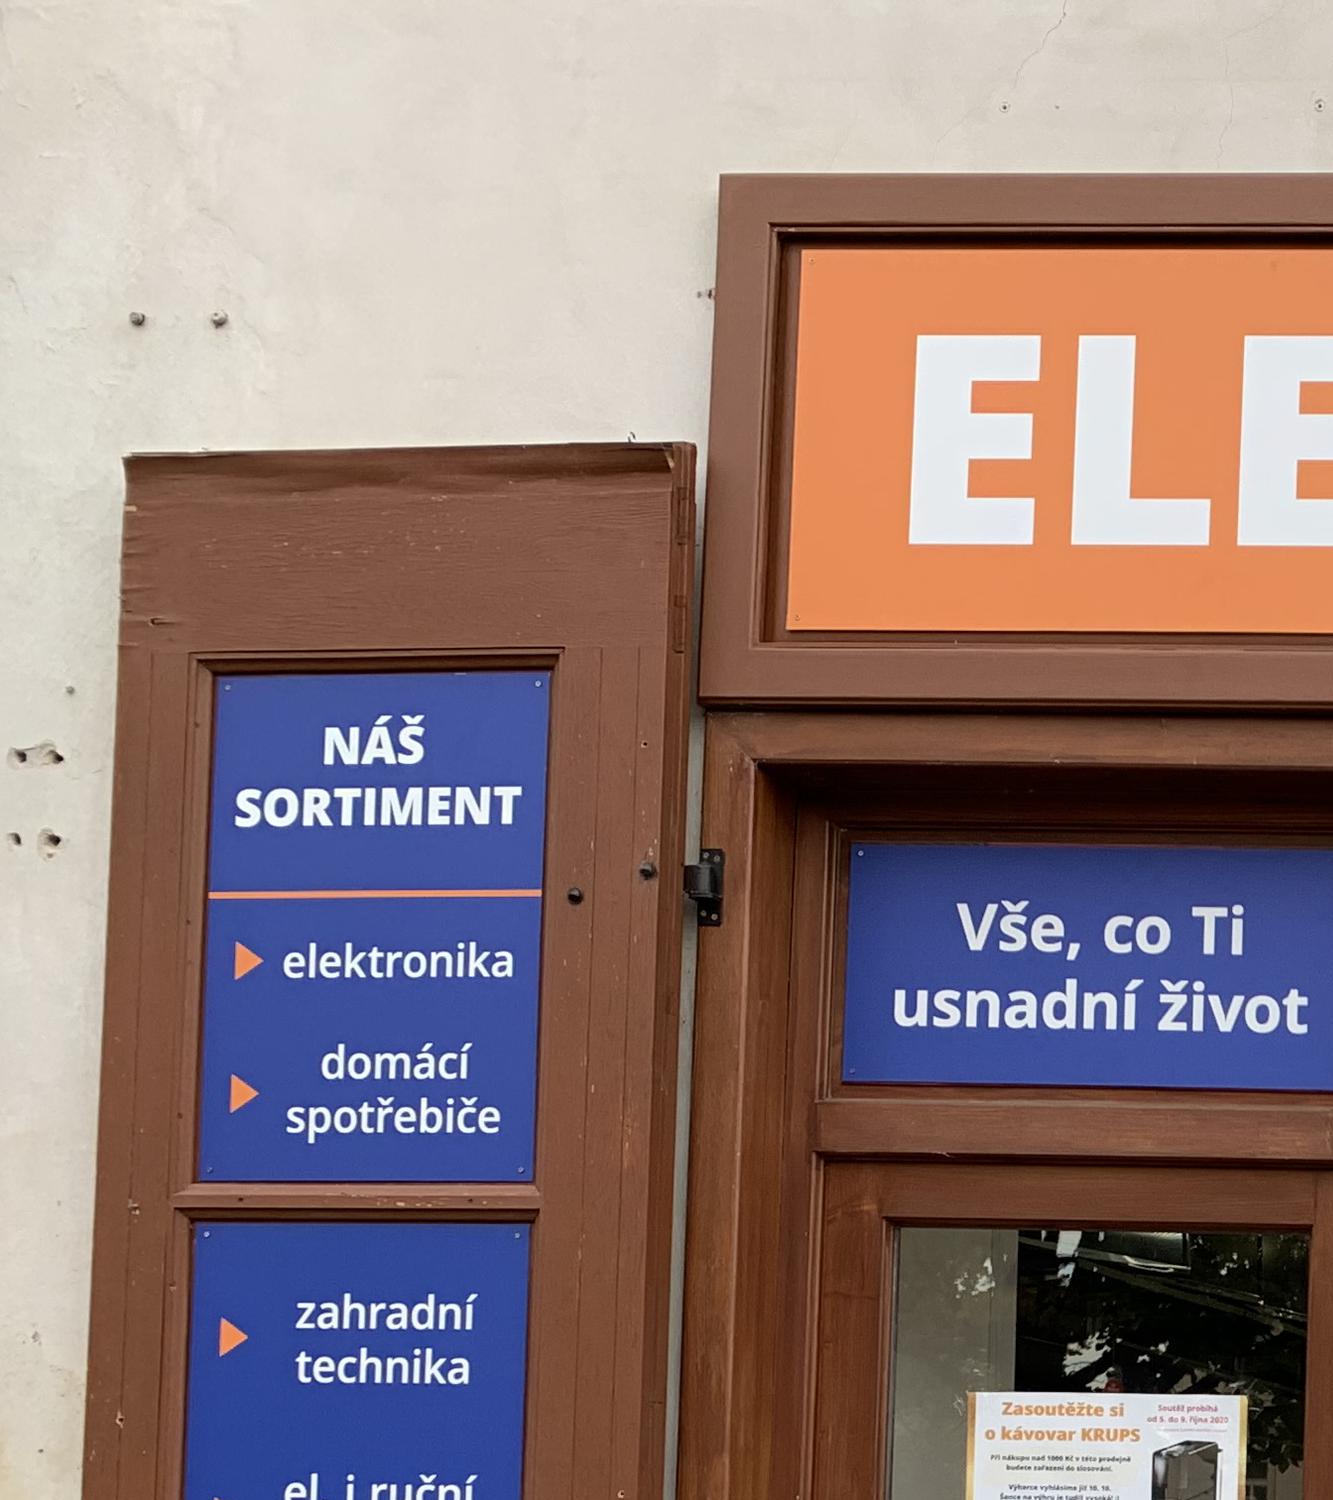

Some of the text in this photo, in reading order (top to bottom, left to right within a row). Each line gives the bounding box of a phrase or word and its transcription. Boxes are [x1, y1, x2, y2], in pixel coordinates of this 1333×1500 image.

[323, 715, 425, 765] NÁŠ
[234, 786, 522, 827] SORTIMENT
[957, 900, 1244, 961] Vše, co Ti
[282, 942, 513, 978] elektronika
[893, 978, 1308, 1035] usnadní život
[321, 1043, 472, 1080] domácí
[286, 1098, 500, 1143] spotřebiče
[295, 1293, 478, 1330] zahradní
[296, 1348, 470, 1385] technika
[1002, 1402, 1124, 1417] Zasoutěžte si
[985, 1426, 1141, 1442] o kávovar KRUPS
